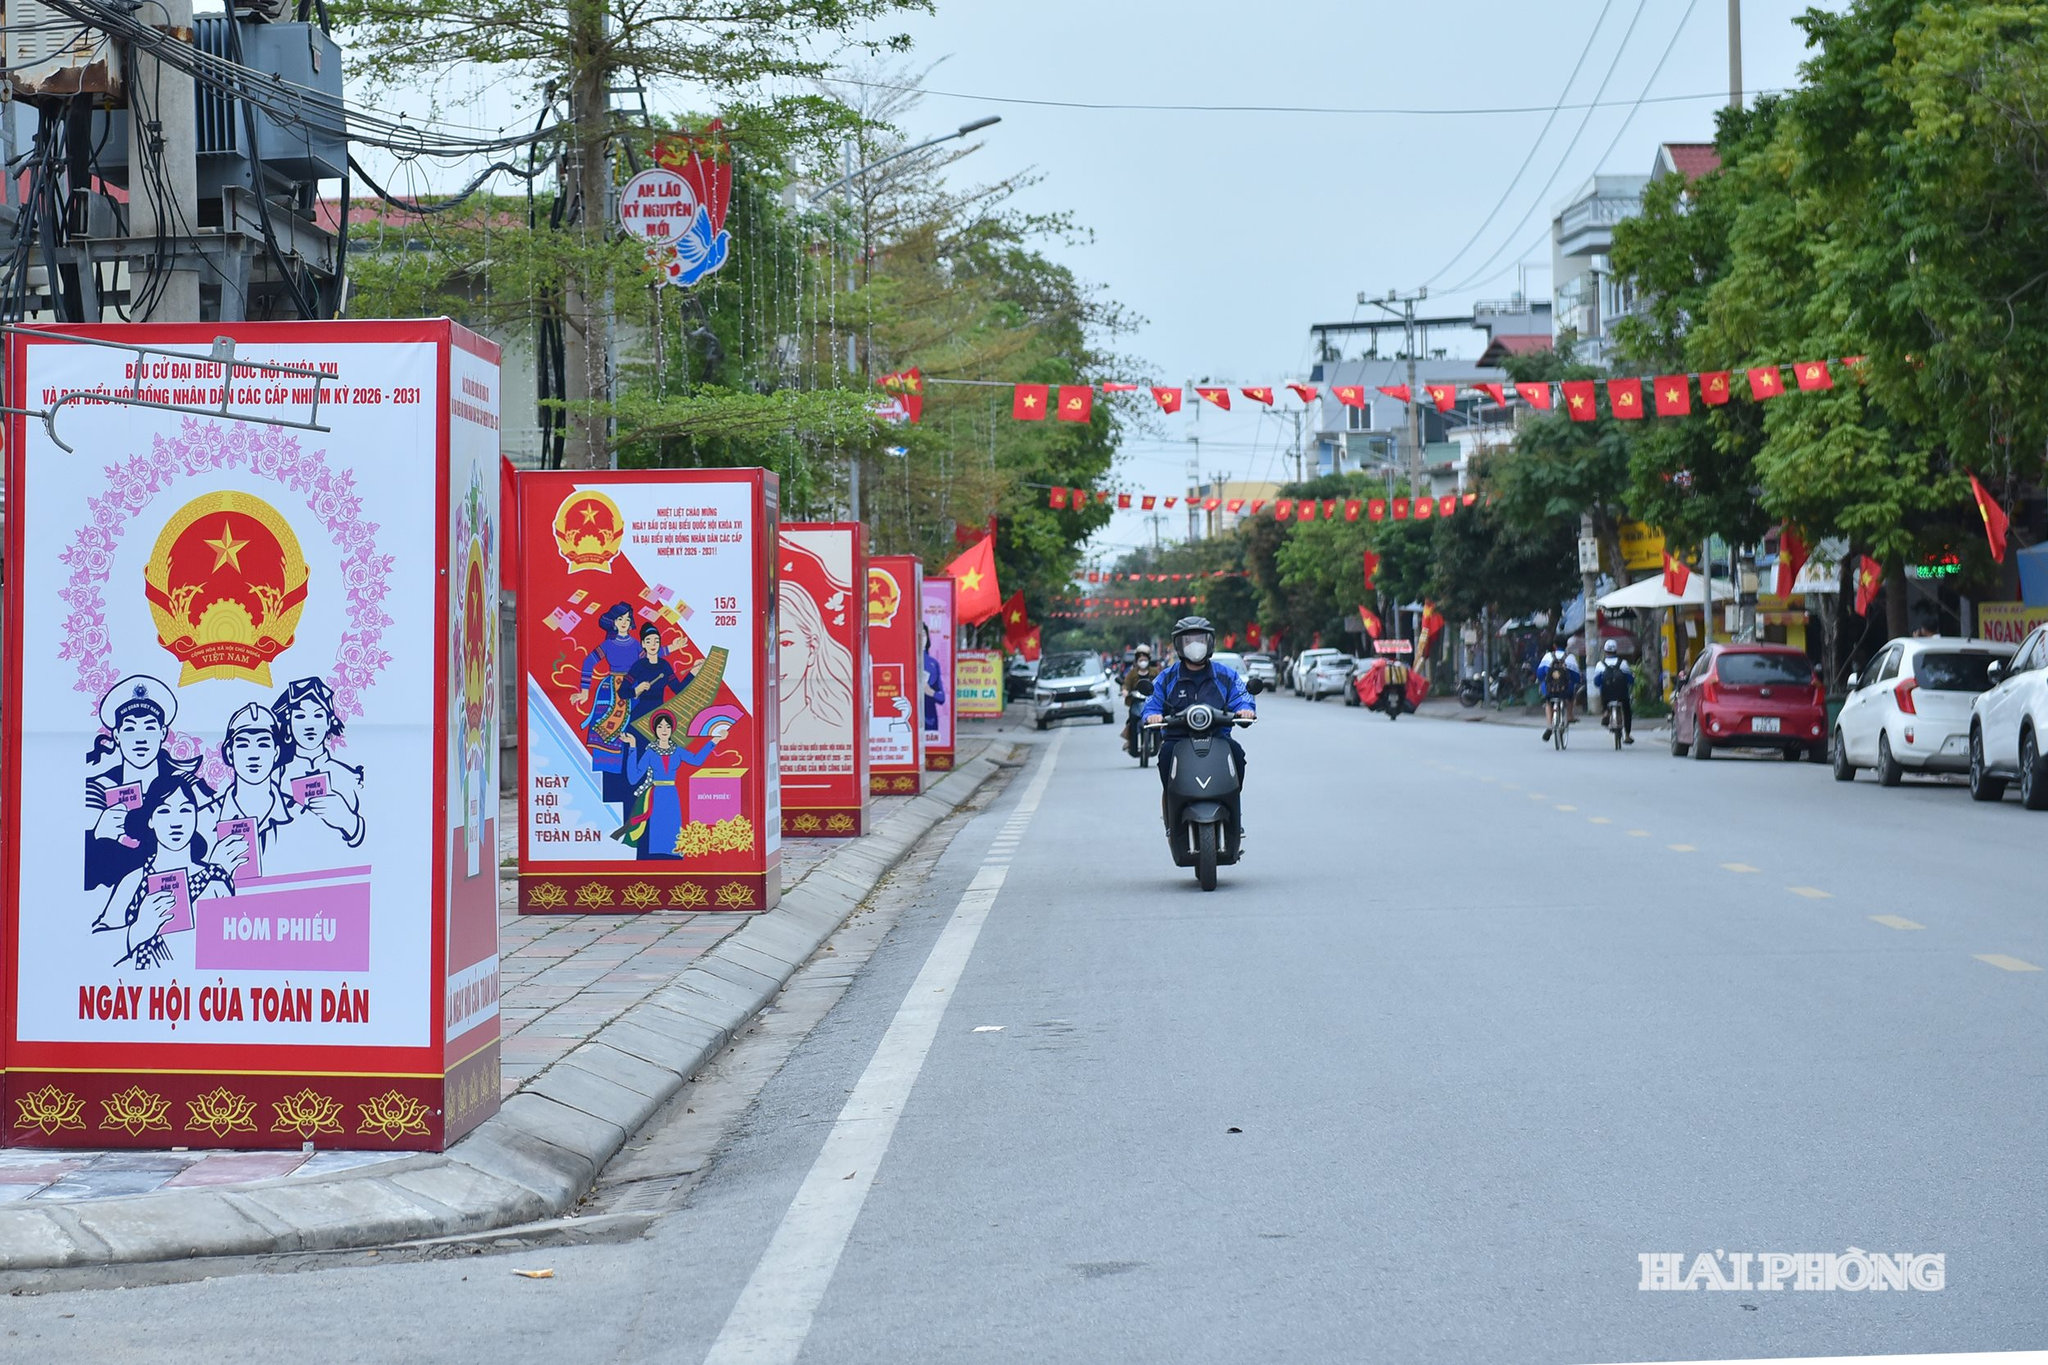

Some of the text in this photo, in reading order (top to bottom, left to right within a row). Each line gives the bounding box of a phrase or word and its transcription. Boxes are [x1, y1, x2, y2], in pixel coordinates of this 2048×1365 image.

[637, 181, 681, 198] AN LÃO
[623, 200, 692, 218] KỶ NGUYÊN
[646, 219, 670, 237] MỚI
[153, 356, 170, 379] CỬ
[172, 363, 191, 383] ĐẠI
[226, 357, 256, 379] UỐC
[42, 385, 58, 405] VÀ
[173, 385, 206, 405] NHÂN
[210, 385, 234, 405] DÂN
[238, 384, 261, 405] CÁC
[265, 382, 288, 405] CẤP
[292, 387, 330, 405] NHIM
[334, 384, 349, 404] KỲ
[353, 388, 381, 404] 2026
[393, 388, 420, 404] 2031
[714, 597, 736, 609] 15/3
[715, 615, 737, 626] 2026
[202, 652, 250, 664] VIỆT NAM
[535, 773, 570, 788] NGÀY
[534, 791, 558, 809] HỘI
[535, 809, 561, 824] CỦA
[535, 827, 601, 842] TOÀN DÂN
[223, 910, 337, 941] HÒM PHIẾU
[79, 976, 369, 1031] NGÀY HỘI CỦA TOÀN DÂN
